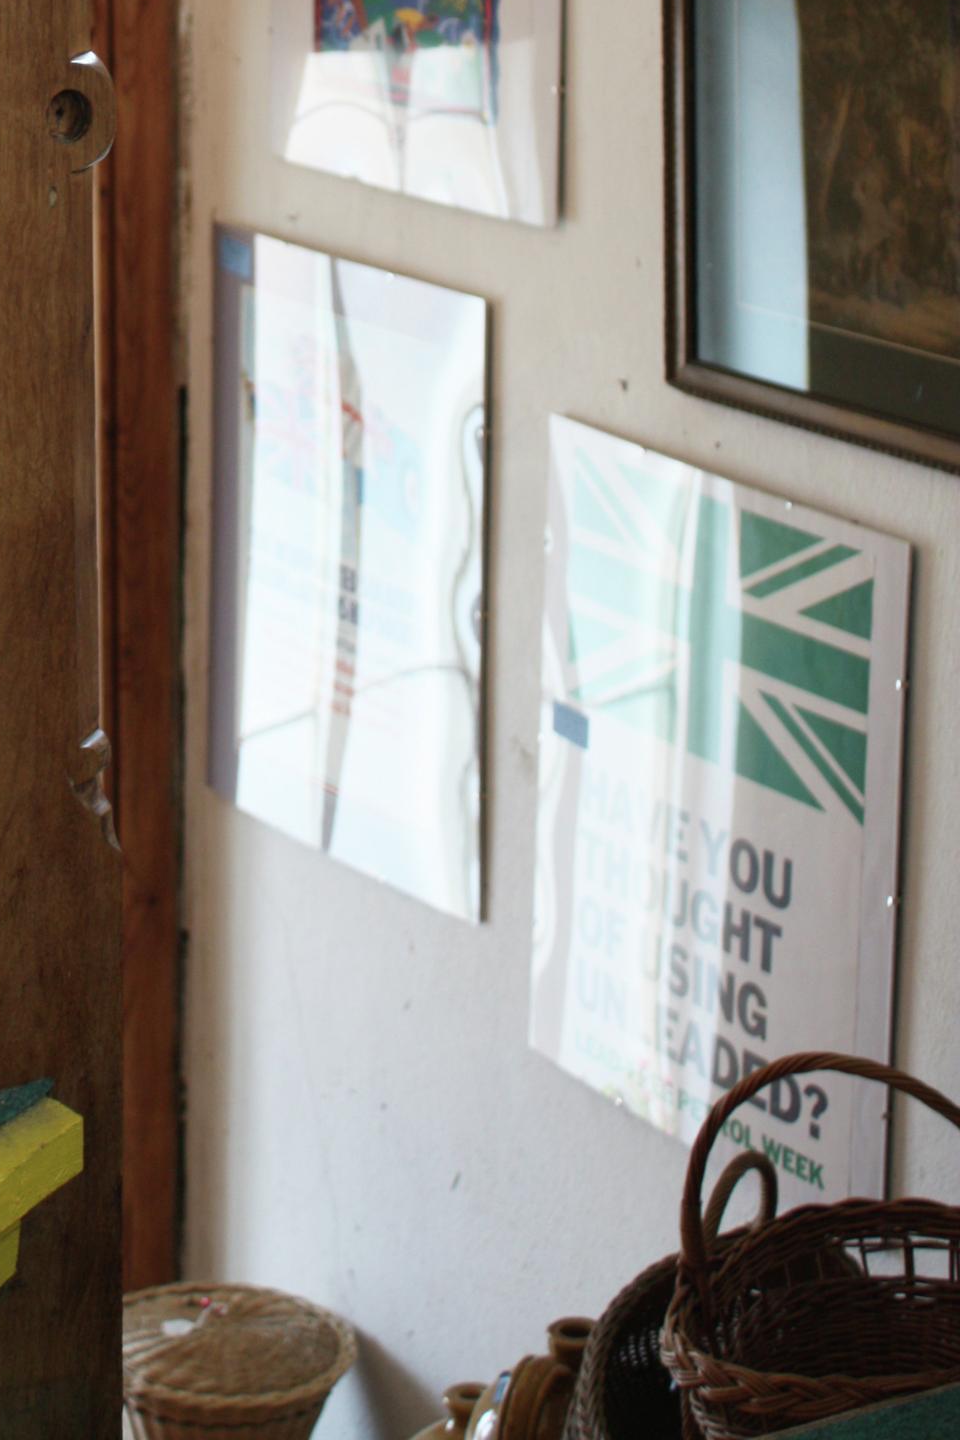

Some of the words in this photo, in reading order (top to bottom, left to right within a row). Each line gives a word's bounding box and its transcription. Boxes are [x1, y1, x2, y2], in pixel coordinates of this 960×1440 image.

[577, 826, 784, 977] THOUGHT
[697, 815, 794, 910] YOU
[578, 894, 628, 960] OF
[641, 926, 769, 1043] USING
[576, 956, 830, 1142] UNEADD?
[677, 1087, 758, 1153] PEOL
[761, 1132, 825, 1191] WEEK
